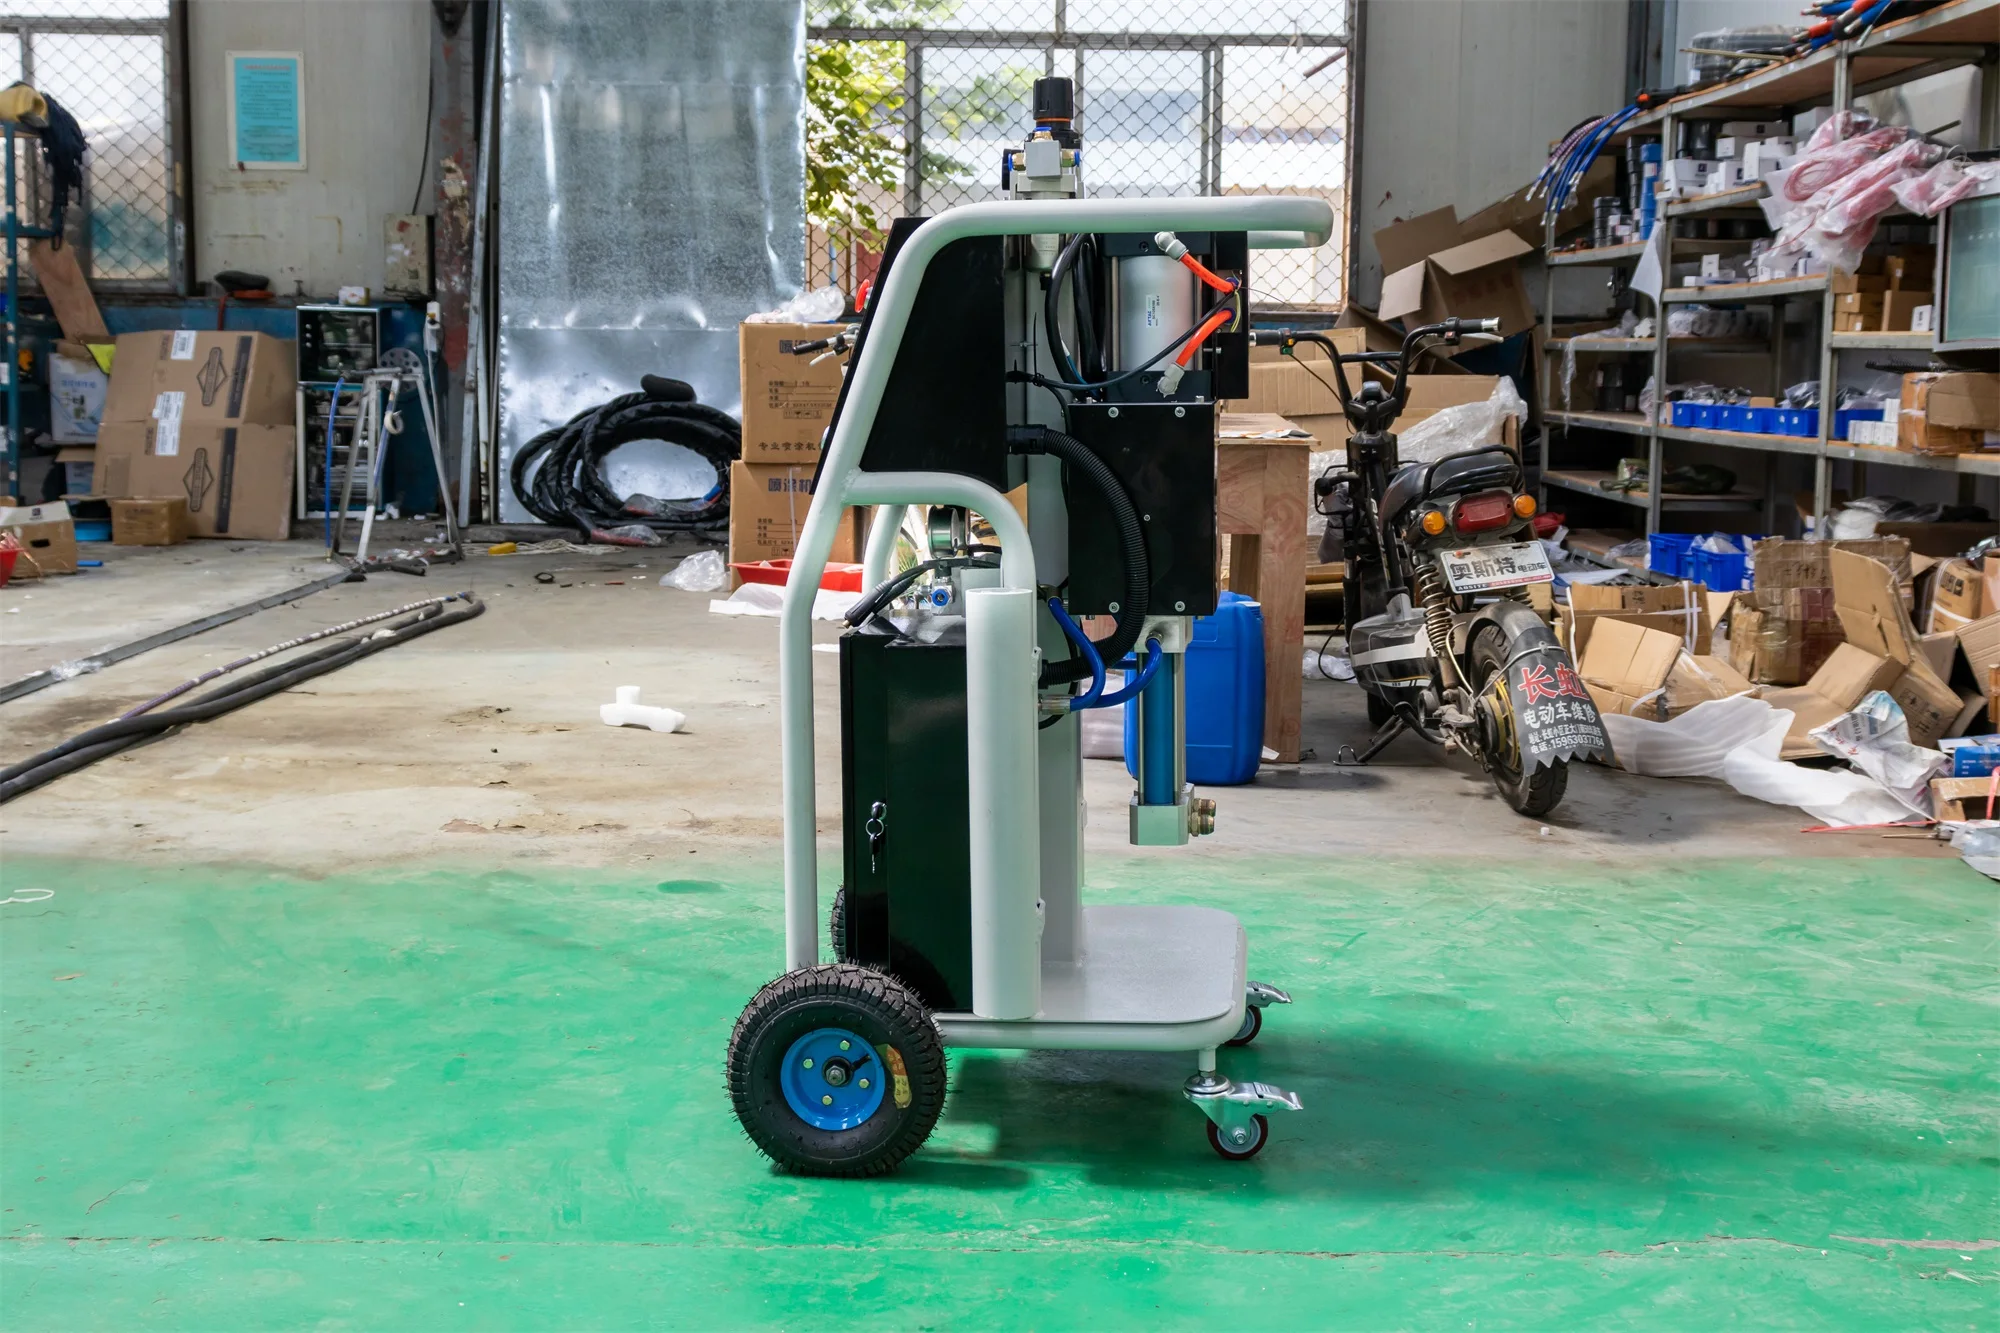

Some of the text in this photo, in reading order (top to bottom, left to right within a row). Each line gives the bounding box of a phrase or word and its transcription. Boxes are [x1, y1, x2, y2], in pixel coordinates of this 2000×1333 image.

[759, 441, 822, 452] 专业喷涂机
[1449, 556, 1517, 581] 奥斯特
[1518, 562, 1547, 573] 电动车
[1517, 661, 1591, 705] 长虹
[1523, 700, 1597, 729] 电动车维修
